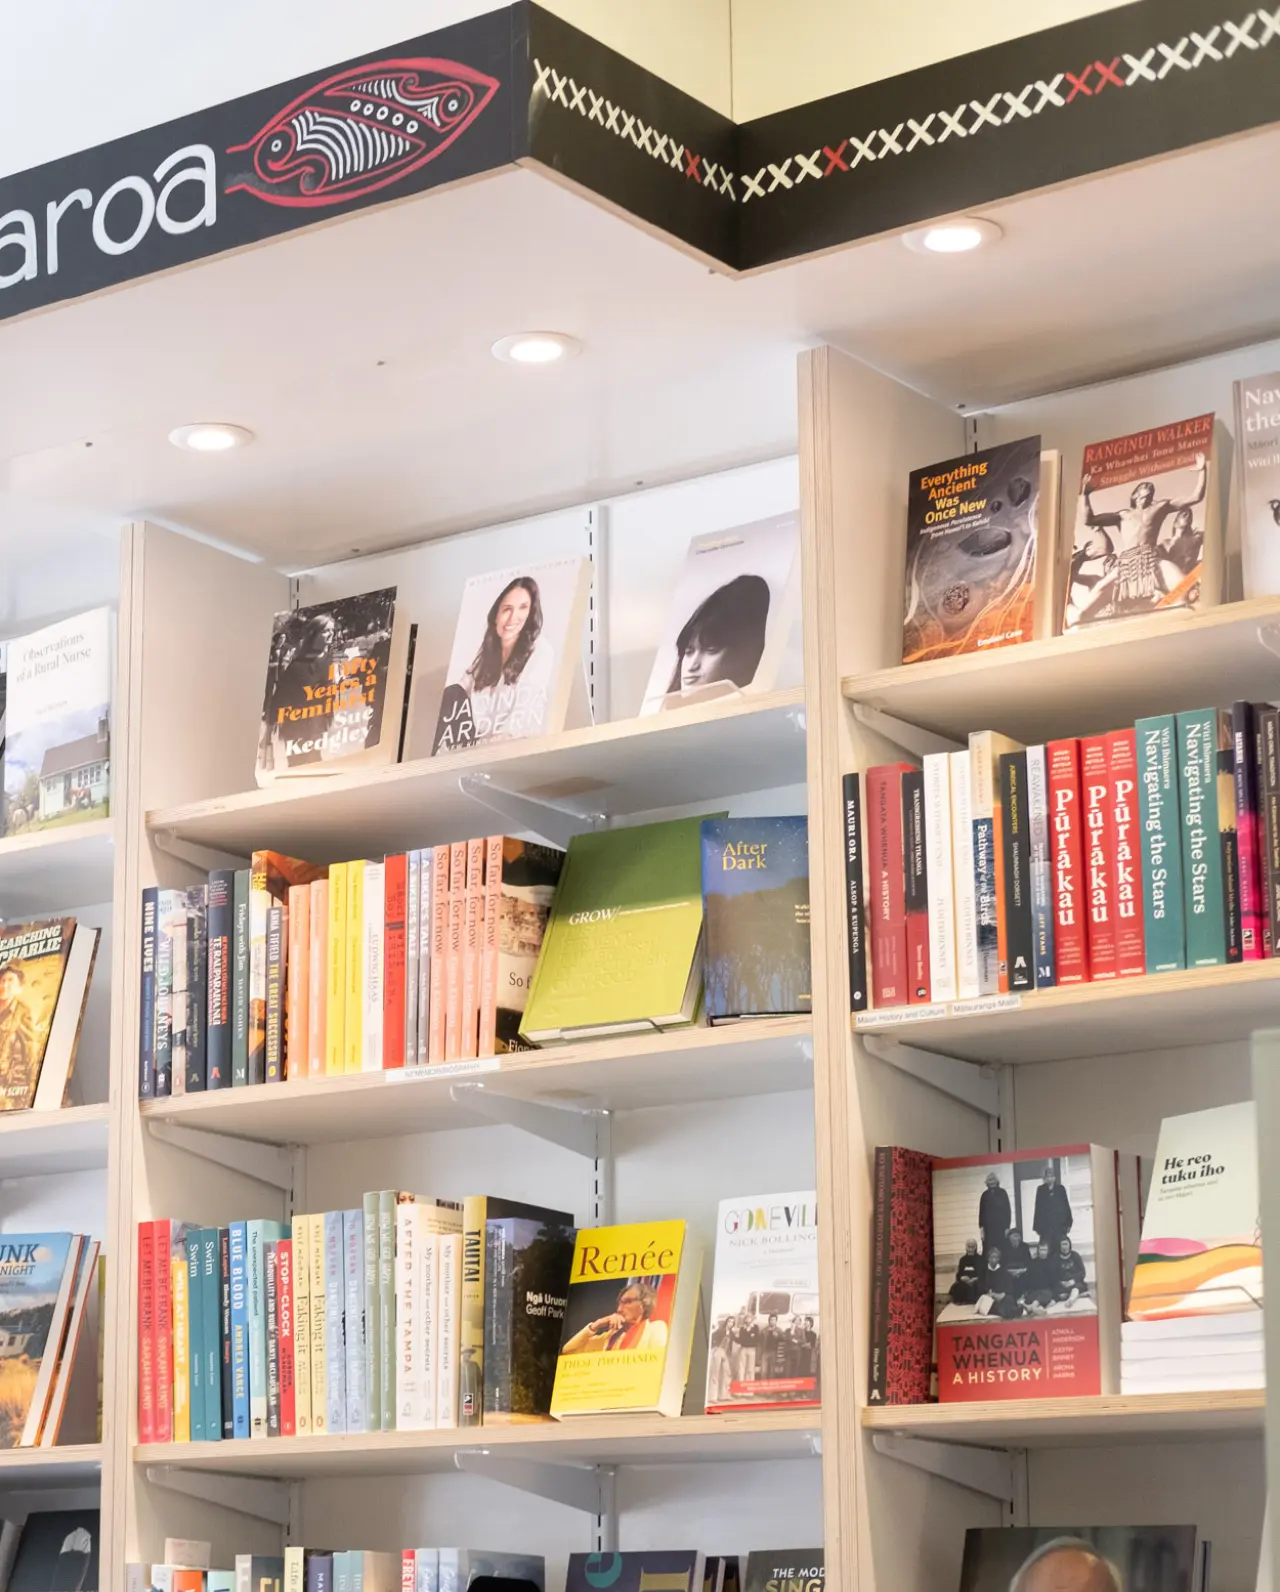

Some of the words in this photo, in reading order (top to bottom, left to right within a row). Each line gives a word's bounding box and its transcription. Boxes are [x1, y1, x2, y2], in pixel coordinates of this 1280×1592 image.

[1085, 432, 1153, 463] RANGINUI
[1157, 417, 1212, 443] WALKER
[921, 462, 989, 490] Everything
[928, 477, 976, 500] Ancient
[925, 507, 956, 524] Once
[960, 499, 987, 515] New
[936, 496, 959, 510] Was
[303, 677, 360, 701] Years
[365, 674, 377, 685] a
[277, 688, 376, 724] Feminist
[334, 707, 374, 730] Sue
[443, 685, 548, 722] JACINDA
[286, 724, 373, 757] Kedgley
[438, 709, 545, 746] ARDERN
[1145, 729, 1162, 832] Navigating
[1185, 724, 1202, 827] Navigating
[722, 841, 768, 858] After
[977, 824, 987, 873] Pathway
[1054, 789, 1075, 927] Pūrākau
[1088, 785, 1108, 923] Pūrākau
[1114, 779, 1135, 918] Pūrākau
[1151, 836, 1167, 866] the
[1191, 830, 1208, 860] the
[436, 852, 448, 870] So
[722, 855, 767, 871] Dark
[1151, 871, 1168, 920] Stars
[1192, 865, 1208, 915] Stars
[144, 901, 155, 933] NINE
[435, 902, 445, 923] for
[980, 895, 991, 926] Birds
[144, 937, 154, 973] LIVES
[269, 964, 279, 980] THE
[508, 971, 524, 989] So
[268, 983, 279, 1010] GREAT
[268, 1013, 278, 1063] SUCCESSOR
[1162, 1169, 1196, 1184] tuku
[1200, 1164, 1225, 1177] iho
[1164, 1157, 1184, 1170] He
[1187, 1154, 1211, 1166] reo
[189, 1244, 199, 1277] Swim
[232, 1229, 242, 1263] BLUE
[464, 1229, 481, 1283] TAUTAI
[578, 1240, 674, 1278] Renée
[0, 1265, 36, 1276] NIGHT
[232, 1266, 243, 1310] BLOOD
[526, 1290, 543, 1306] Ngā
[280, 1293, 291, 1338] CLOCK
[526, 1304, 547, 1316] Geoff
[548, 1307, 564, 1319] Park
[403, 1319, 413, 1374] TAMPA
[952, 1330, 1040, 1351] TANGATA
[952, 1350, 1042, 1370] WHENUA
[953, 1371, 963, 1385] A
[969, 1368, 1042, 1384] HISTORY
[773, 1568, 795, 1578] THE
